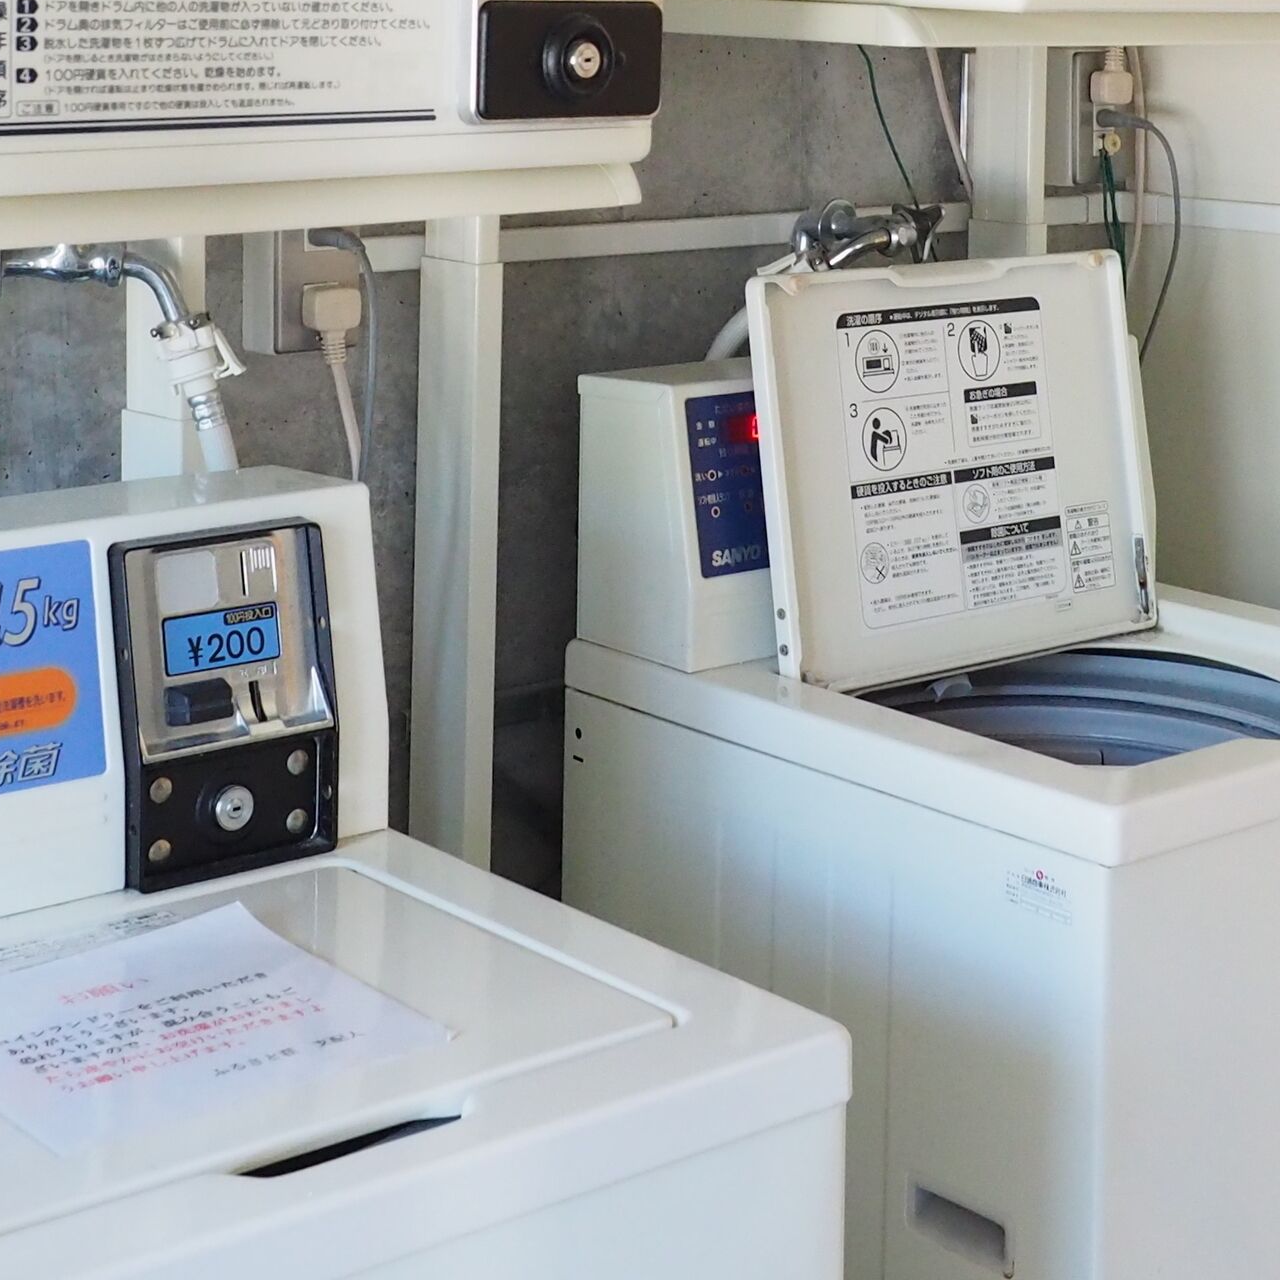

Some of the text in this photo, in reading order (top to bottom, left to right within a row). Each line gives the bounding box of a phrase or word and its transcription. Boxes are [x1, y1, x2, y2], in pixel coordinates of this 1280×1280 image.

[947, 322, 956, 337] 2
[844, 332, 851, 347] 1
[849, 402, 859, 418] 3
[712, 544, 761, 568] SANYO
[187, 626, 266, 668] ¥200
